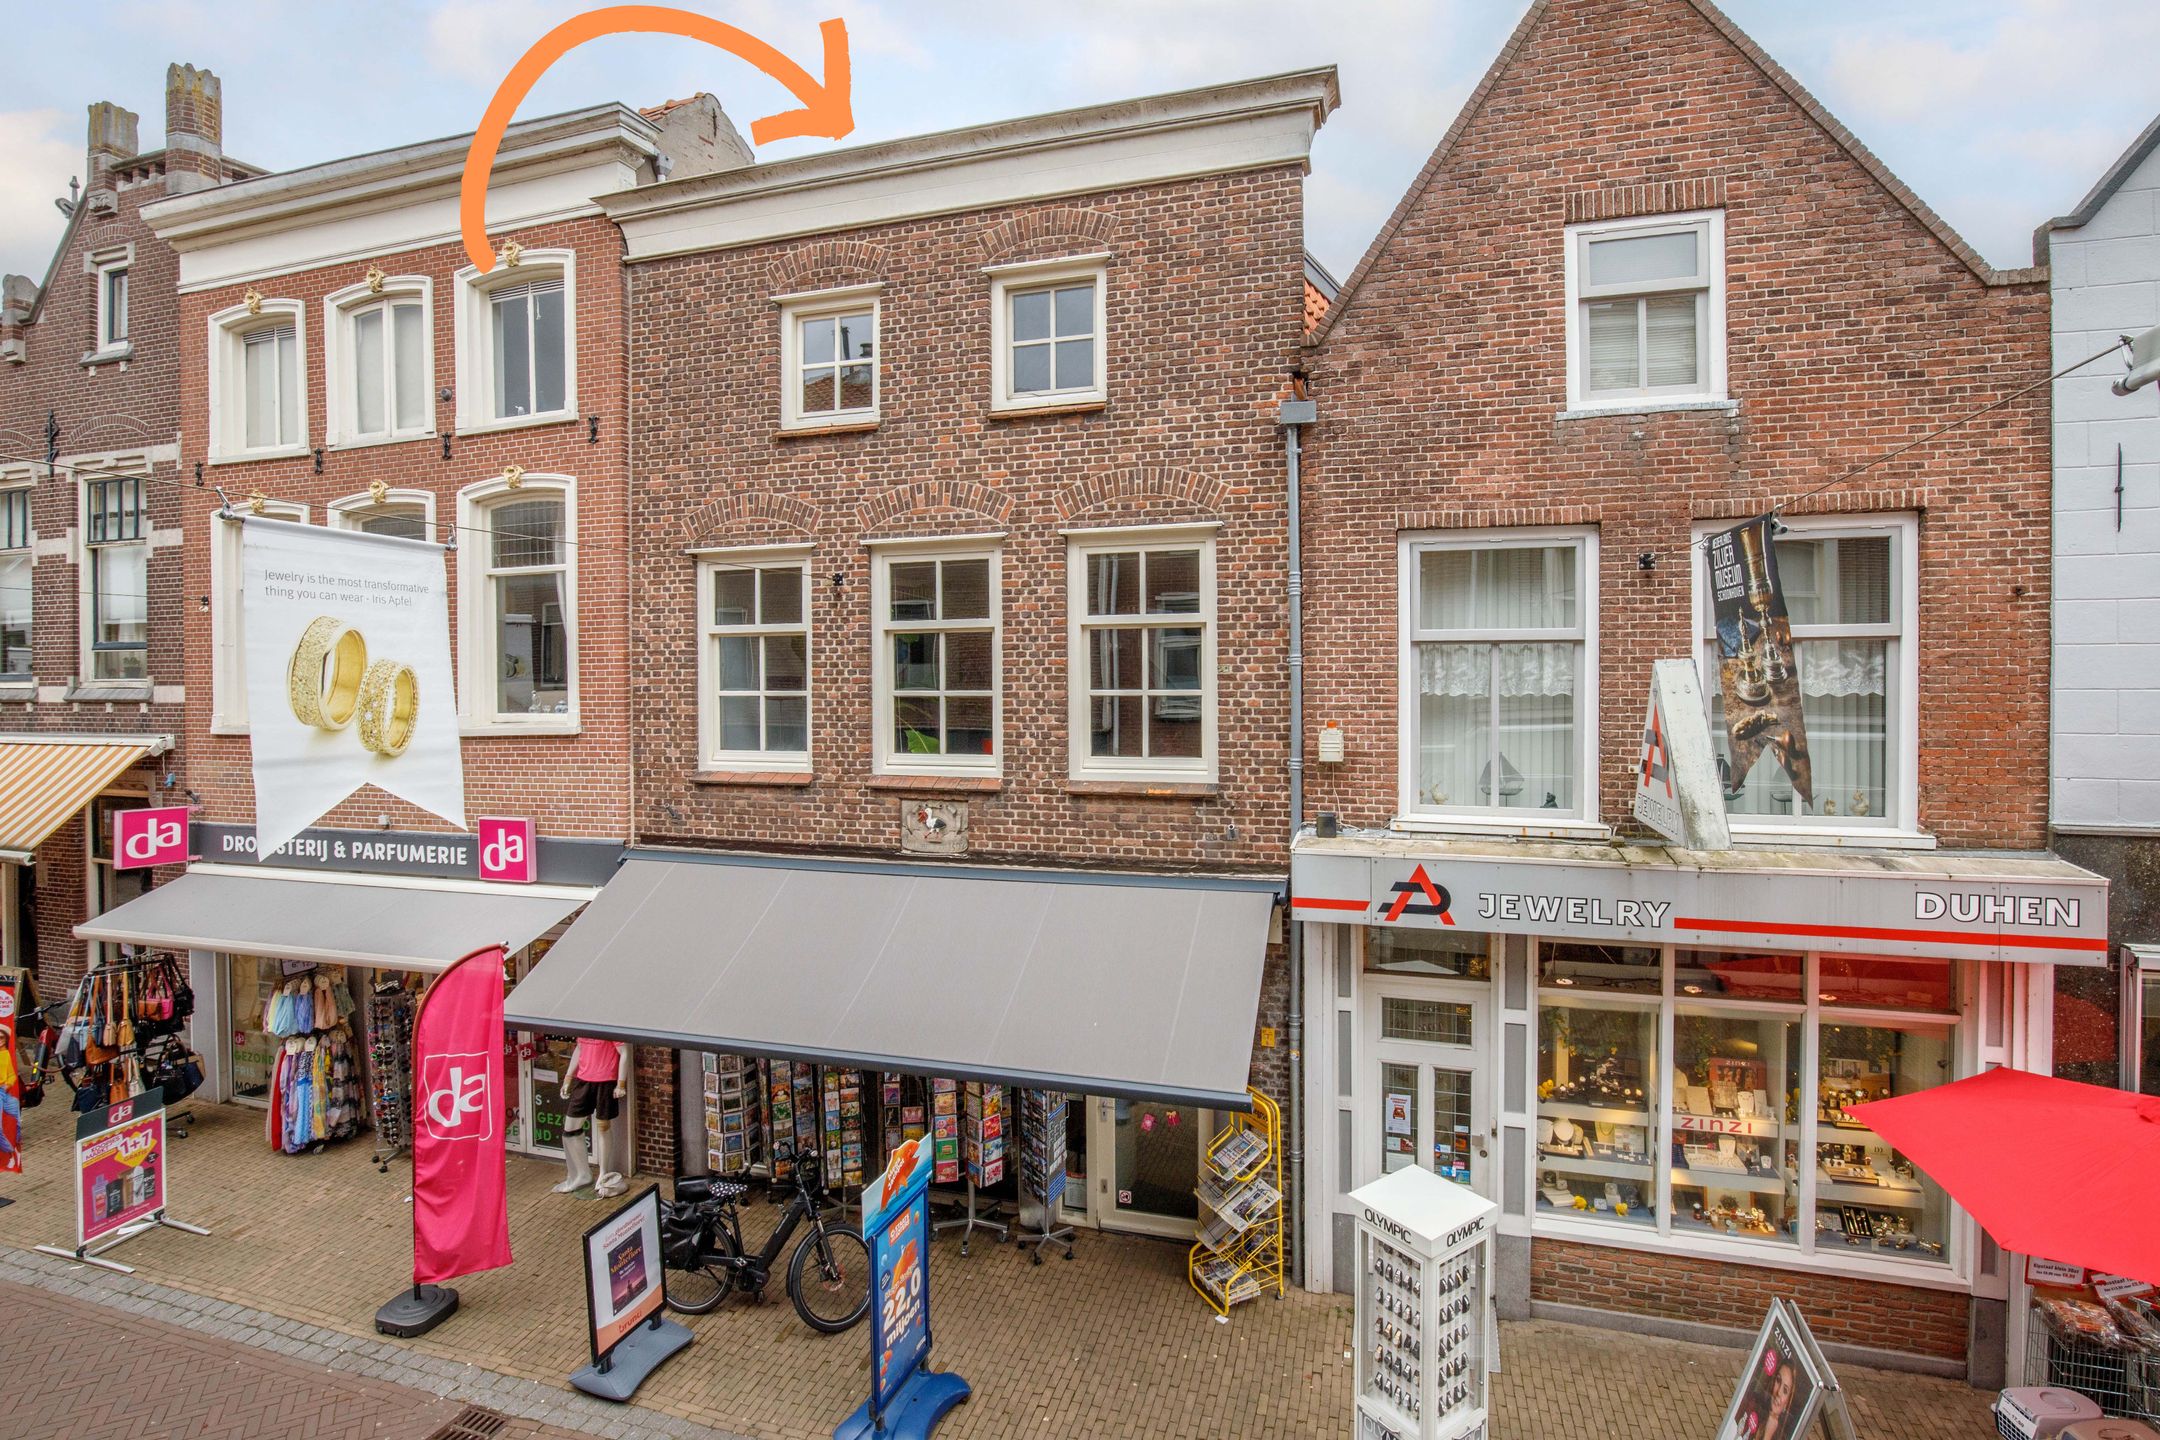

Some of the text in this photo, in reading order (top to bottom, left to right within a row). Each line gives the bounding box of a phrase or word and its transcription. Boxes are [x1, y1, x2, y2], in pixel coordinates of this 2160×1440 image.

[1713, 544, 1735, 570] ZILVER
[264, 569, 430, 594] Jewelry is the most transformative
[1715, 563, 1743, 590] MUSEUM
[265, 586, 294, 600] thing
[297, 589, 316, 600] you
[319, 591, 337, 600] can
[340, 593, 363, 603] wear
[372, 594, 387, 604] Iris
[388, 595, 412, 607] Apfel
[126, 818, 182, 859] da
[222, 834, 468, 866] DROSTERIJ & PARFUMERIE
[483, 828, 524, 871] da
[1478, 892, 1671, 928] JEWELRY
[1915, 891, 2080, 928] DUHEN
[520, 1047, 532, 1058] da
[110, 1104, 133, 1124] da
[428, 1066, 486, 1128] da
[1364, 1208, 1411, 1244] OLYMPIC
[1446, 1217, 1485, 1247] OLYMPIC
[883, 1266, 921, 1333] 22,0
[886, 1298, 920, 1348] miljoen
